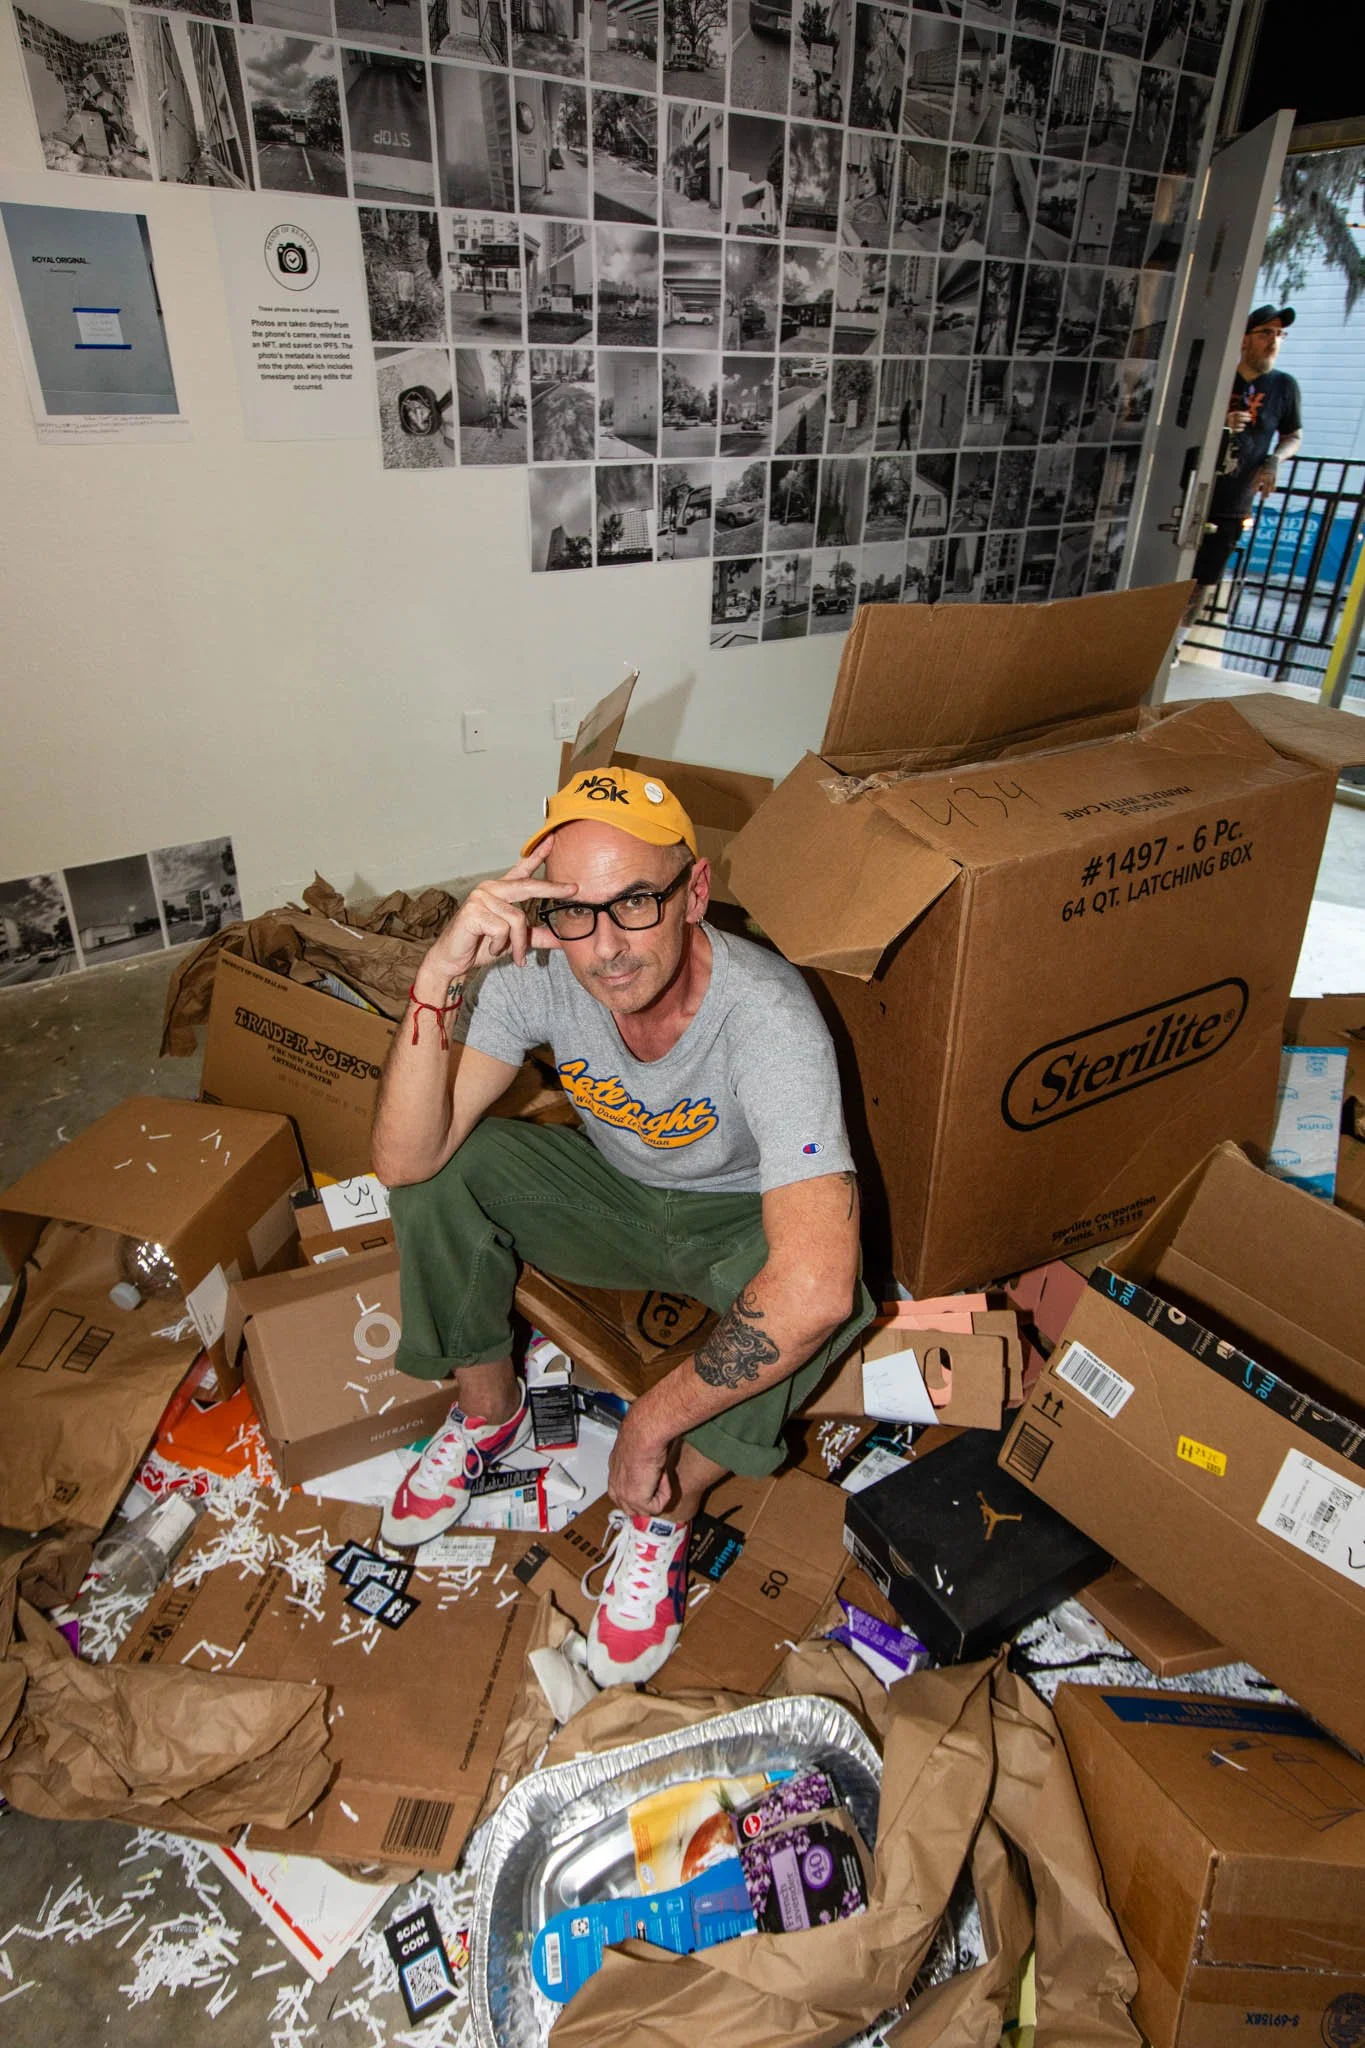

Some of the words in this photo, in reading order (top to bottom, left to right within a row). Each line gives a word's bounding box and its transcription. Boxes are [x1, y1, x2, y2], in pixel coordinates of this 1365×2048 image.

[373, 130, 412, 148] STOP
[32, 256, 55, 264] ROYAL
[251, 319, 275, 327] Photos
[309, 321, 333, 330] directly
[574, 775, 616, 794] NO
[586, 786, 630, 805] OK
[1061, 801, 1105, 821] CARE
[1081, 836, 1168, 887] #1497
[1193, 824, 1209, 853] 6
[1062, 897, 1086, 922] 64
[1093, 887, 1121, 914] QT.
[1128, 856, 1215, 902] LATCHING
[1219, 841, 1254, 872] BOX
[235, 1006, 308, 1052] TRADER
[310, 1041, 371, 1080] JOE'S
[287, 1052, 304, 1066] NEW
[303, 1061, 340, 1080] ZEALAND
[305, 1069, 332, 1086] WATER
[596, 1106, 625, 1124] David
[1094, 1194, 1157, 1225] Corporation
[1096, 1222, 1111, 1234] TX
[370, 1418, 424, 1443] NUTRAFOL
[708, 1537, 738, 1577] prime
[760, 1569, 789, 1600] 50
[809, 1853, 825, 1880] 40
[780, 1883, 795, 1929] French
[396, 1917, 426, 1942] SCAN
[401, 1931, 430, 1956] CODE
